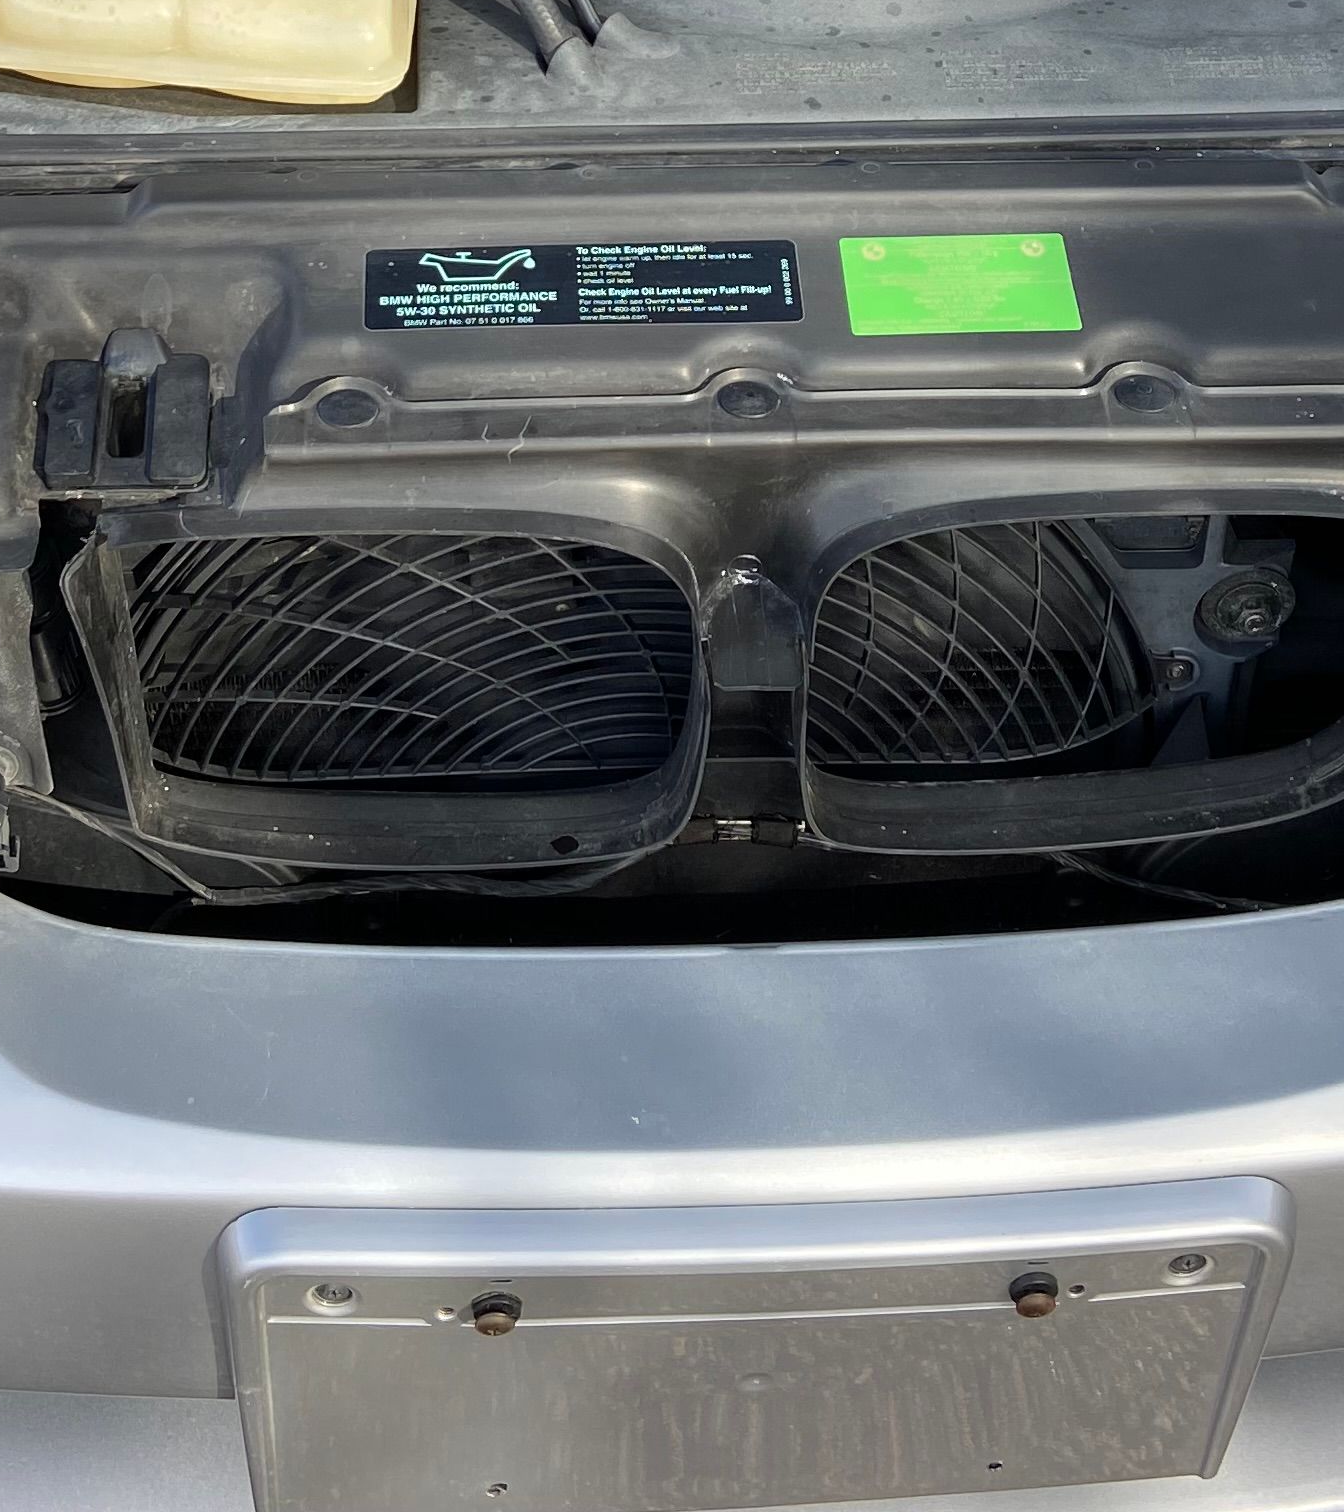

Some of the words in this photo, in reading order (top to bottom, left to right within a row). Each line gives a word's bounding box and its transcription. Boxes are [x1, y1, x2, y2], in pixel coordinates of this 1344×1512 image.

[576, 246, 589, 255] To
[591, 246, 622, 255] Check
[624, 246, 658, 255] Engine
[661, 245, 675, 253] Oil
[678, 245, 707, 253] Level:
[416, 283, 437, 293] We
[440, 281, 519, 292] recommend:
[578, 288, 607, 296] Check
[608, 287, 639, 297] Engine
[641, 287, 655, 295] Oil
[656, 287, 680, 296] Level
[682, 287, 691, 295] at
[693, 288, 717, 297] every
[719, 286, 739, 295] Fuel
[741, 285, 772, 295] Fill-up!
[379, 296, 414, 305] BMW
[416, 294, 450, 304] HIGH
[453, 291, 557, 303] PERFORMANCE
[396, 306, 435, 316] 5W-30
[439, 304, 515, 315] SYNTHETIC
[518, 303, 541, 313] OIL
[430, 318, 447, 326] Part
[465, 317, 476, 325] 07
